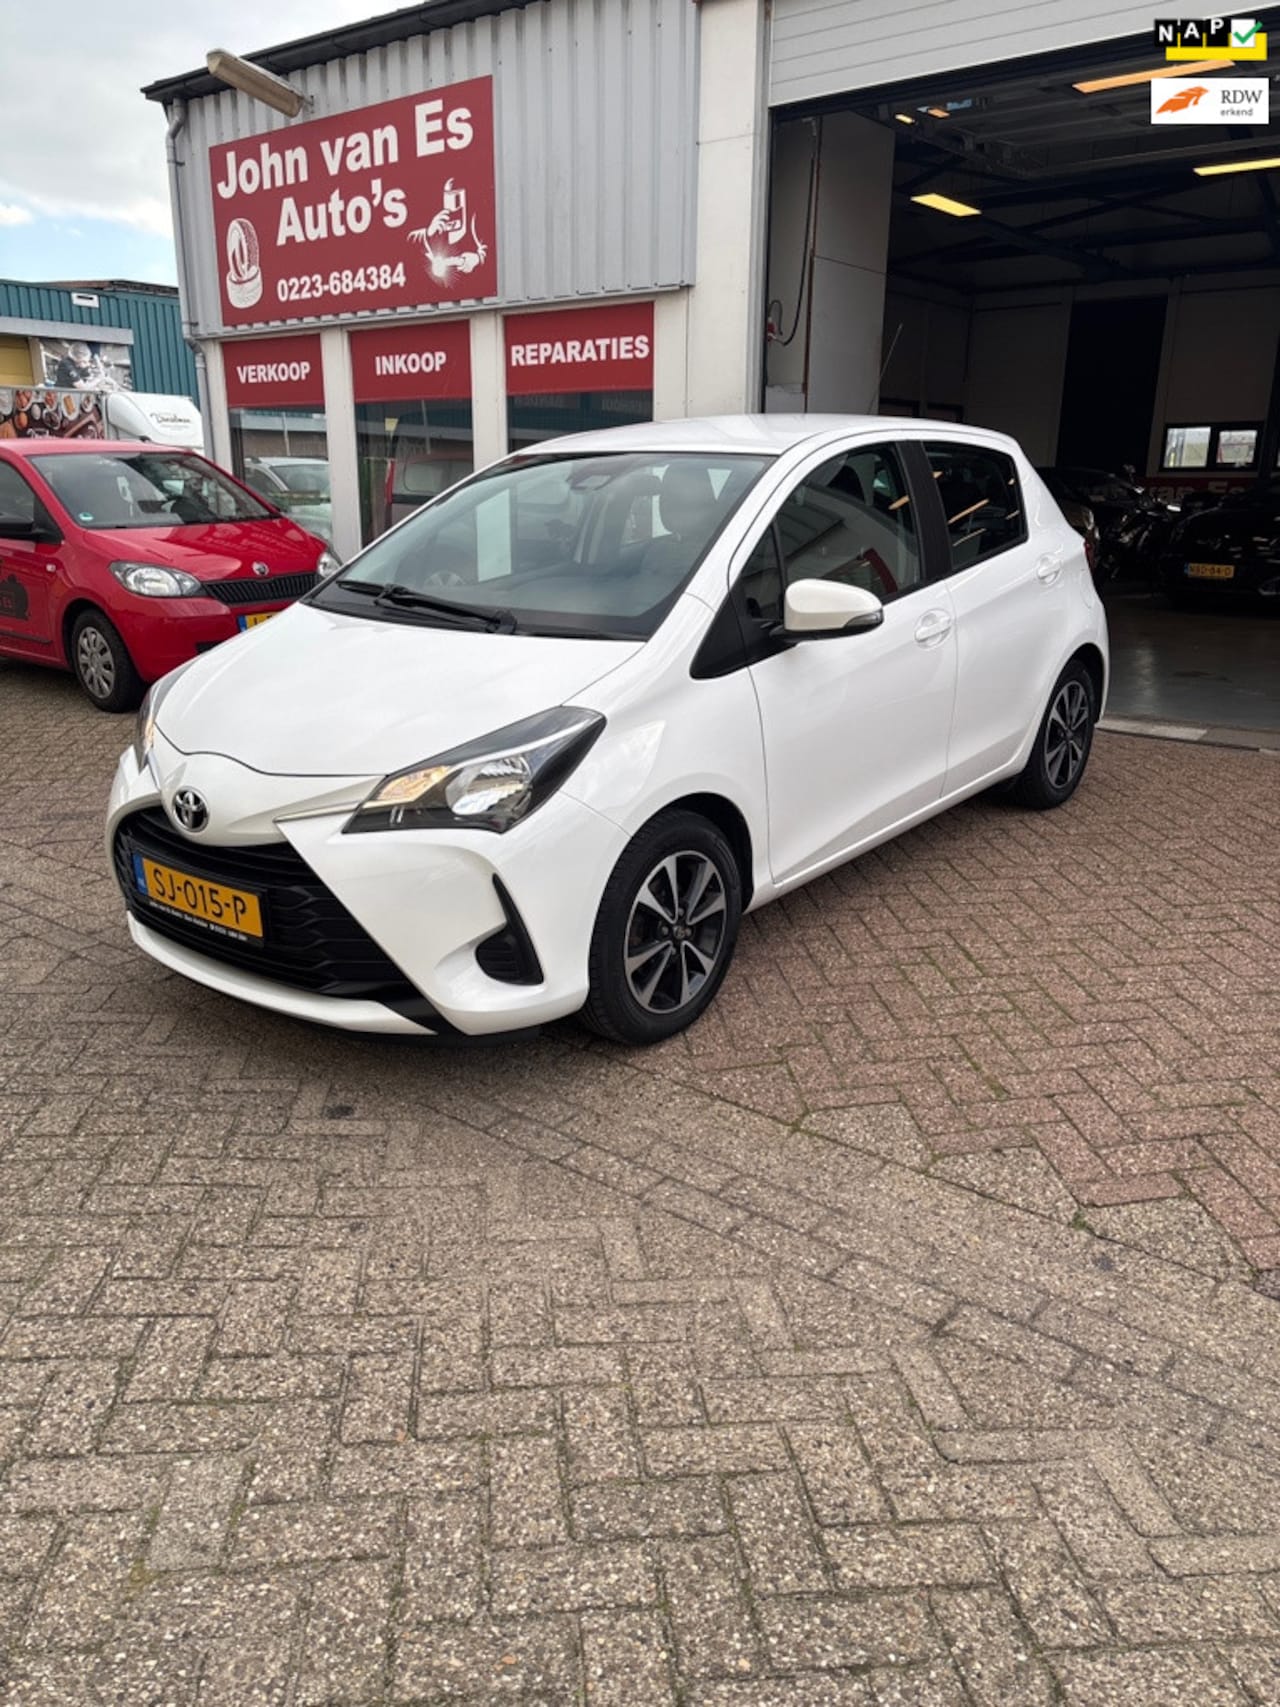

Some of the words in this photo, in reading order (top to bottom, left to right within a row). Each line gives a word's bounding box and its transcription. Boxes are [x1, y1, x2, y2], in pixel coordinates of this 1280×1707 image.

[217, 142, 309, 200] John
[320, 125, 399, 176] van
[415, 99, 474, 158] Es
[276, 178, 408, 246] Auto's
[277, 262, 406, 302] 0223-684384
[375, 351, 447, 376] INKOOP
[511, 335, 650, 367] REPARATIES
[237, 361, 311, 384] VERKOOP
[153, 868, 247, 925] SJ-015-P
